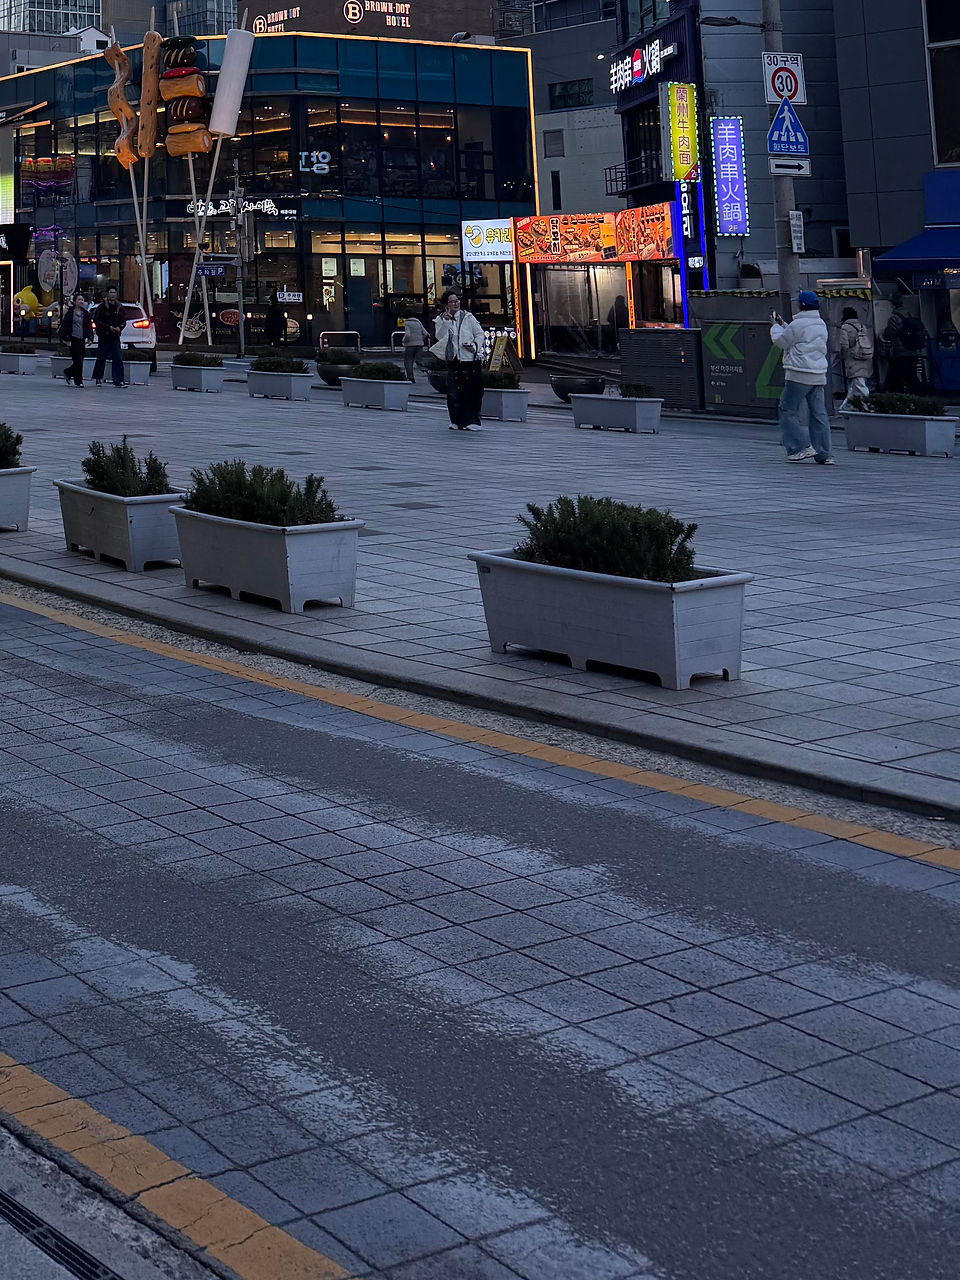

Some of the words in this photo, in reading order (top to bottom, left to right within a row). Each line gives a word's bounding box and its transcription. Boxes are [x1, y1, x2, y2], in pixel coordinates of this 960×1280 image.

[386, 15, 411, 28] HOTEL
[610, 56, 632, 94] 羊肉串
[643, 39, 661, 79] 火鍋
[766, 55, 779, 67] 30
[780, 55, 800, 67] 구역
[776, 74, 793, 93] 30
[773, 143, 806, 152] 횡단보도
[718, 122, 742, 222] 羊肉串火鍋
[728, 224, 739, 233] 2F
